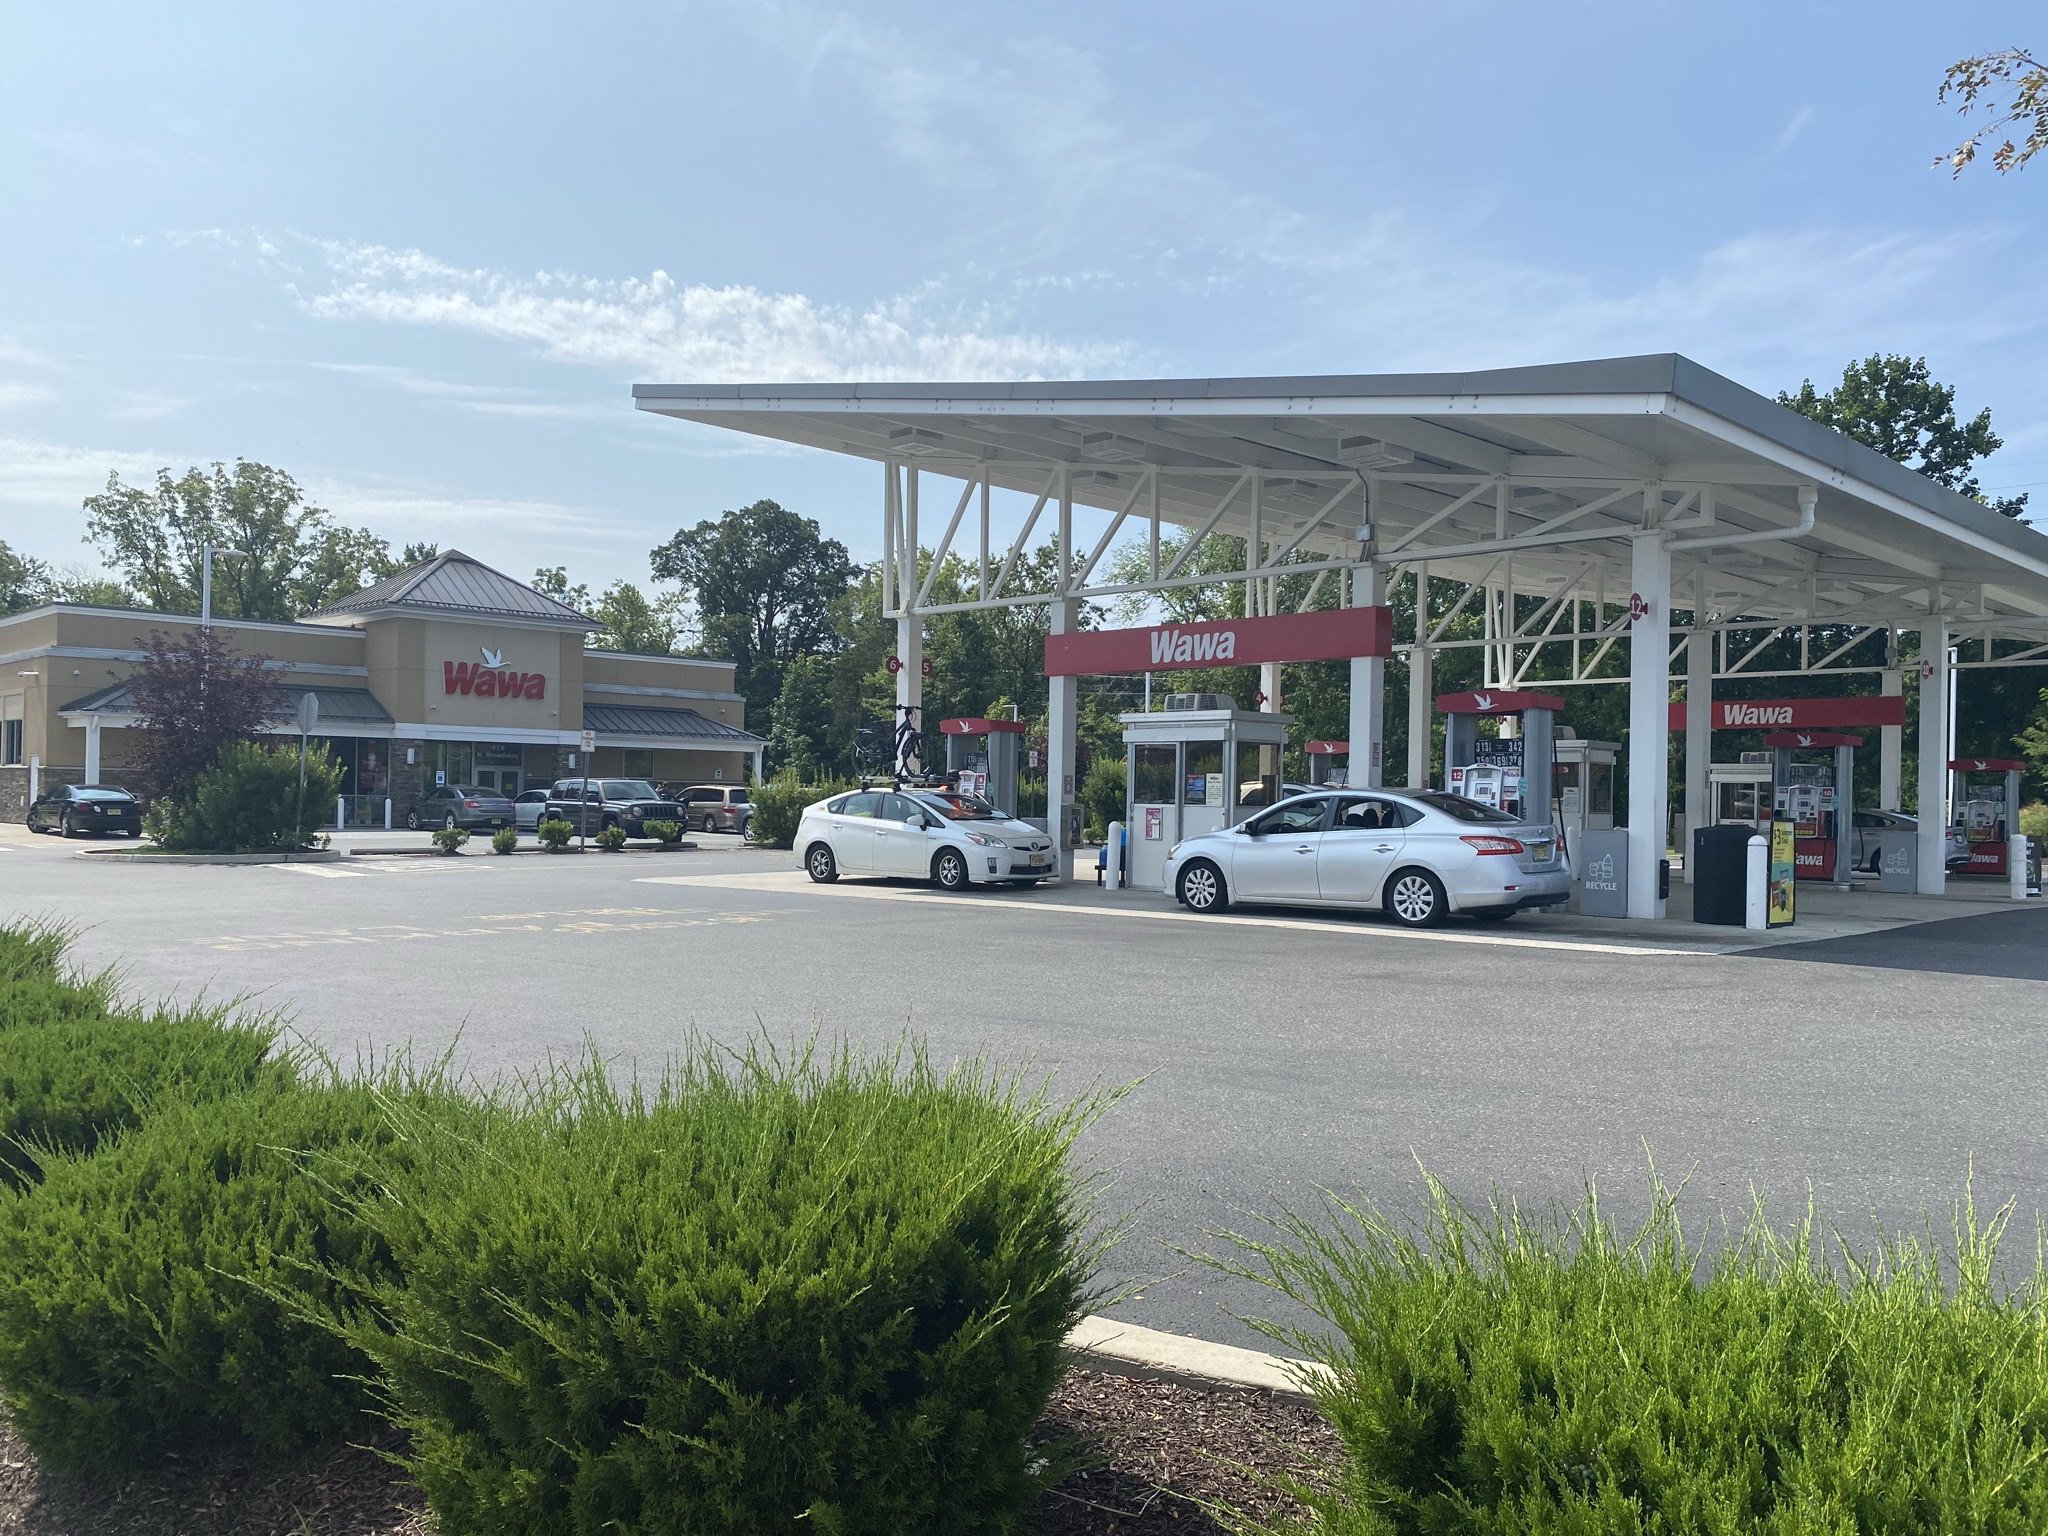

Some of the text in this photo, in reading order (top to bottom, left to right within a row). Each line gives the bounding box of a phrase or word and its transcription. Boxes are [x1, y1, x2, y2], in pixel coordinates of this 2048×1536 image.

[1630, 599, 1641, 615] 12
[1151, 629, 1236, 664] Wawa
[890, 660, 897, 670] 6
[923, 662, 930, 673] 5
[443, 660, 546, 699] Wawa
[1255, 693, 1262, 702] 4
[1724, 704, 1793, 725] Wawa
[485, 751, 519, 759] Broadway
[1452, 771, 1463, 779] 12
[1796, 852, 1823, 866] awa
[1885, 867, 1911, 875] RECYCLE
[1585, 881, 1618, 891] RECYCLE
